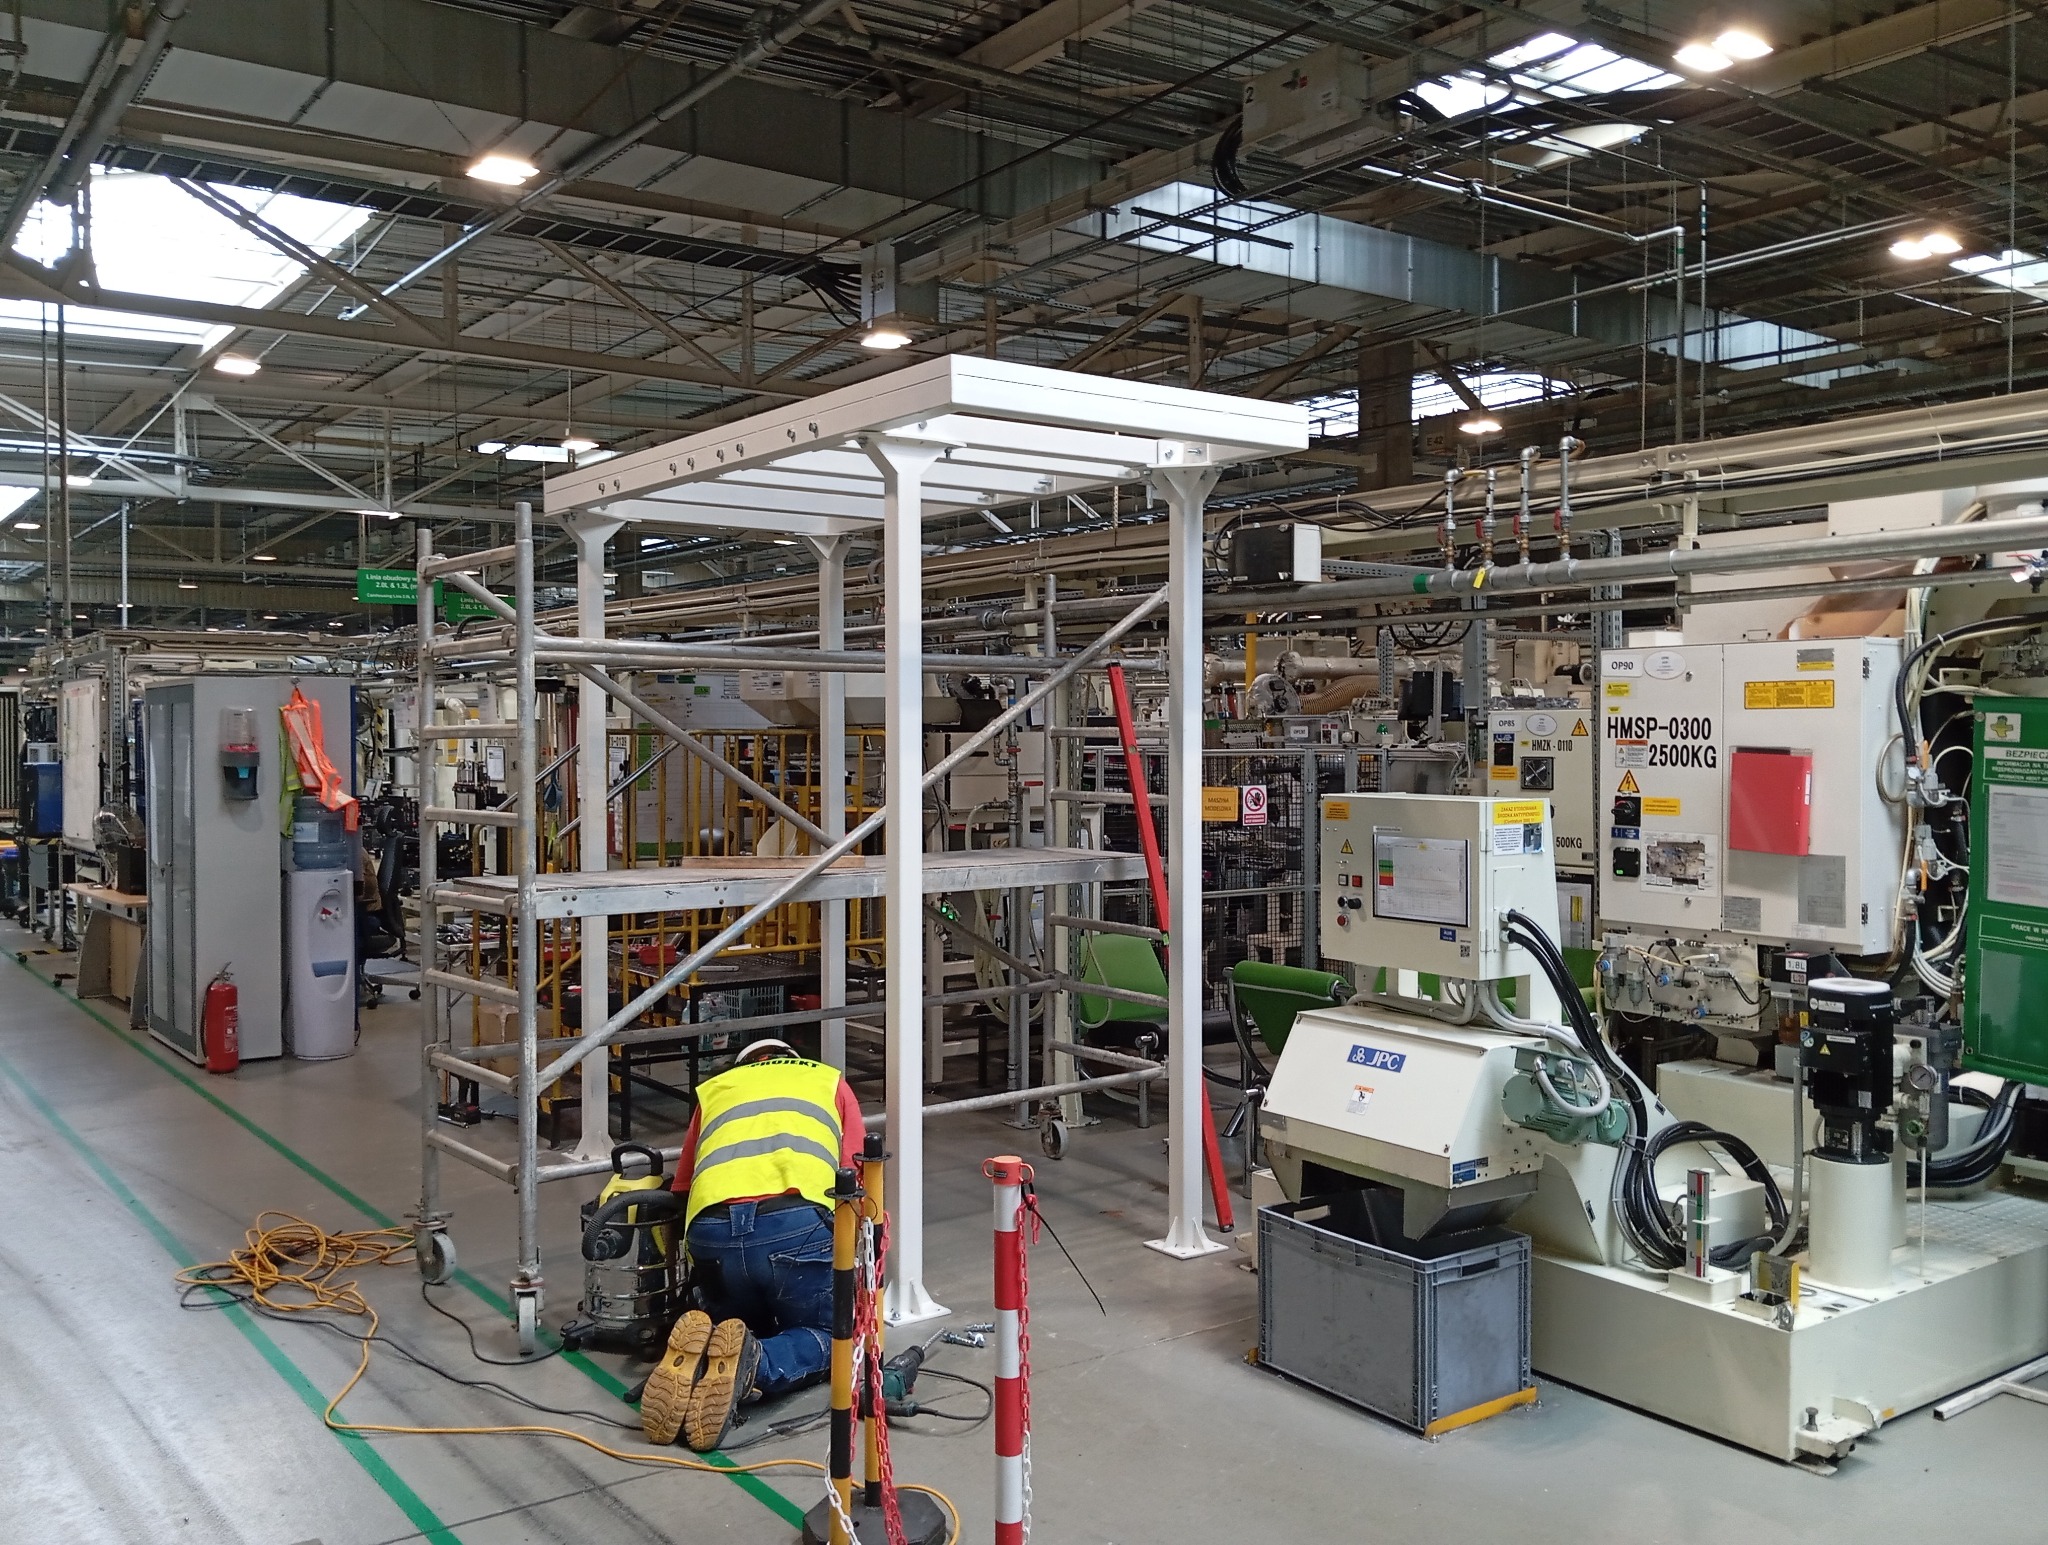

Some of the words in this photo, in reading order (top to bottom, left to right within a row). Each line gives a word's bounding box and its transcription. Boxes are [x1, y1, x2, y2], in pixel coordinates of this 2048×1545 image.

[1611, 661, 1634, 670] OP90
[1607, 717, 1711, 740] HMSP-0300
[1531, 739, 1551, 751] HMZK
[1558, 739, 1573, 751] 0110
[1648, 744, 1717, 768] 2500KG
[1555, 837, 1582, 849] 500KG
[1788, 960, 1805, 970] 1.8L
[1366, 1050, 1400, 1070] JPC
